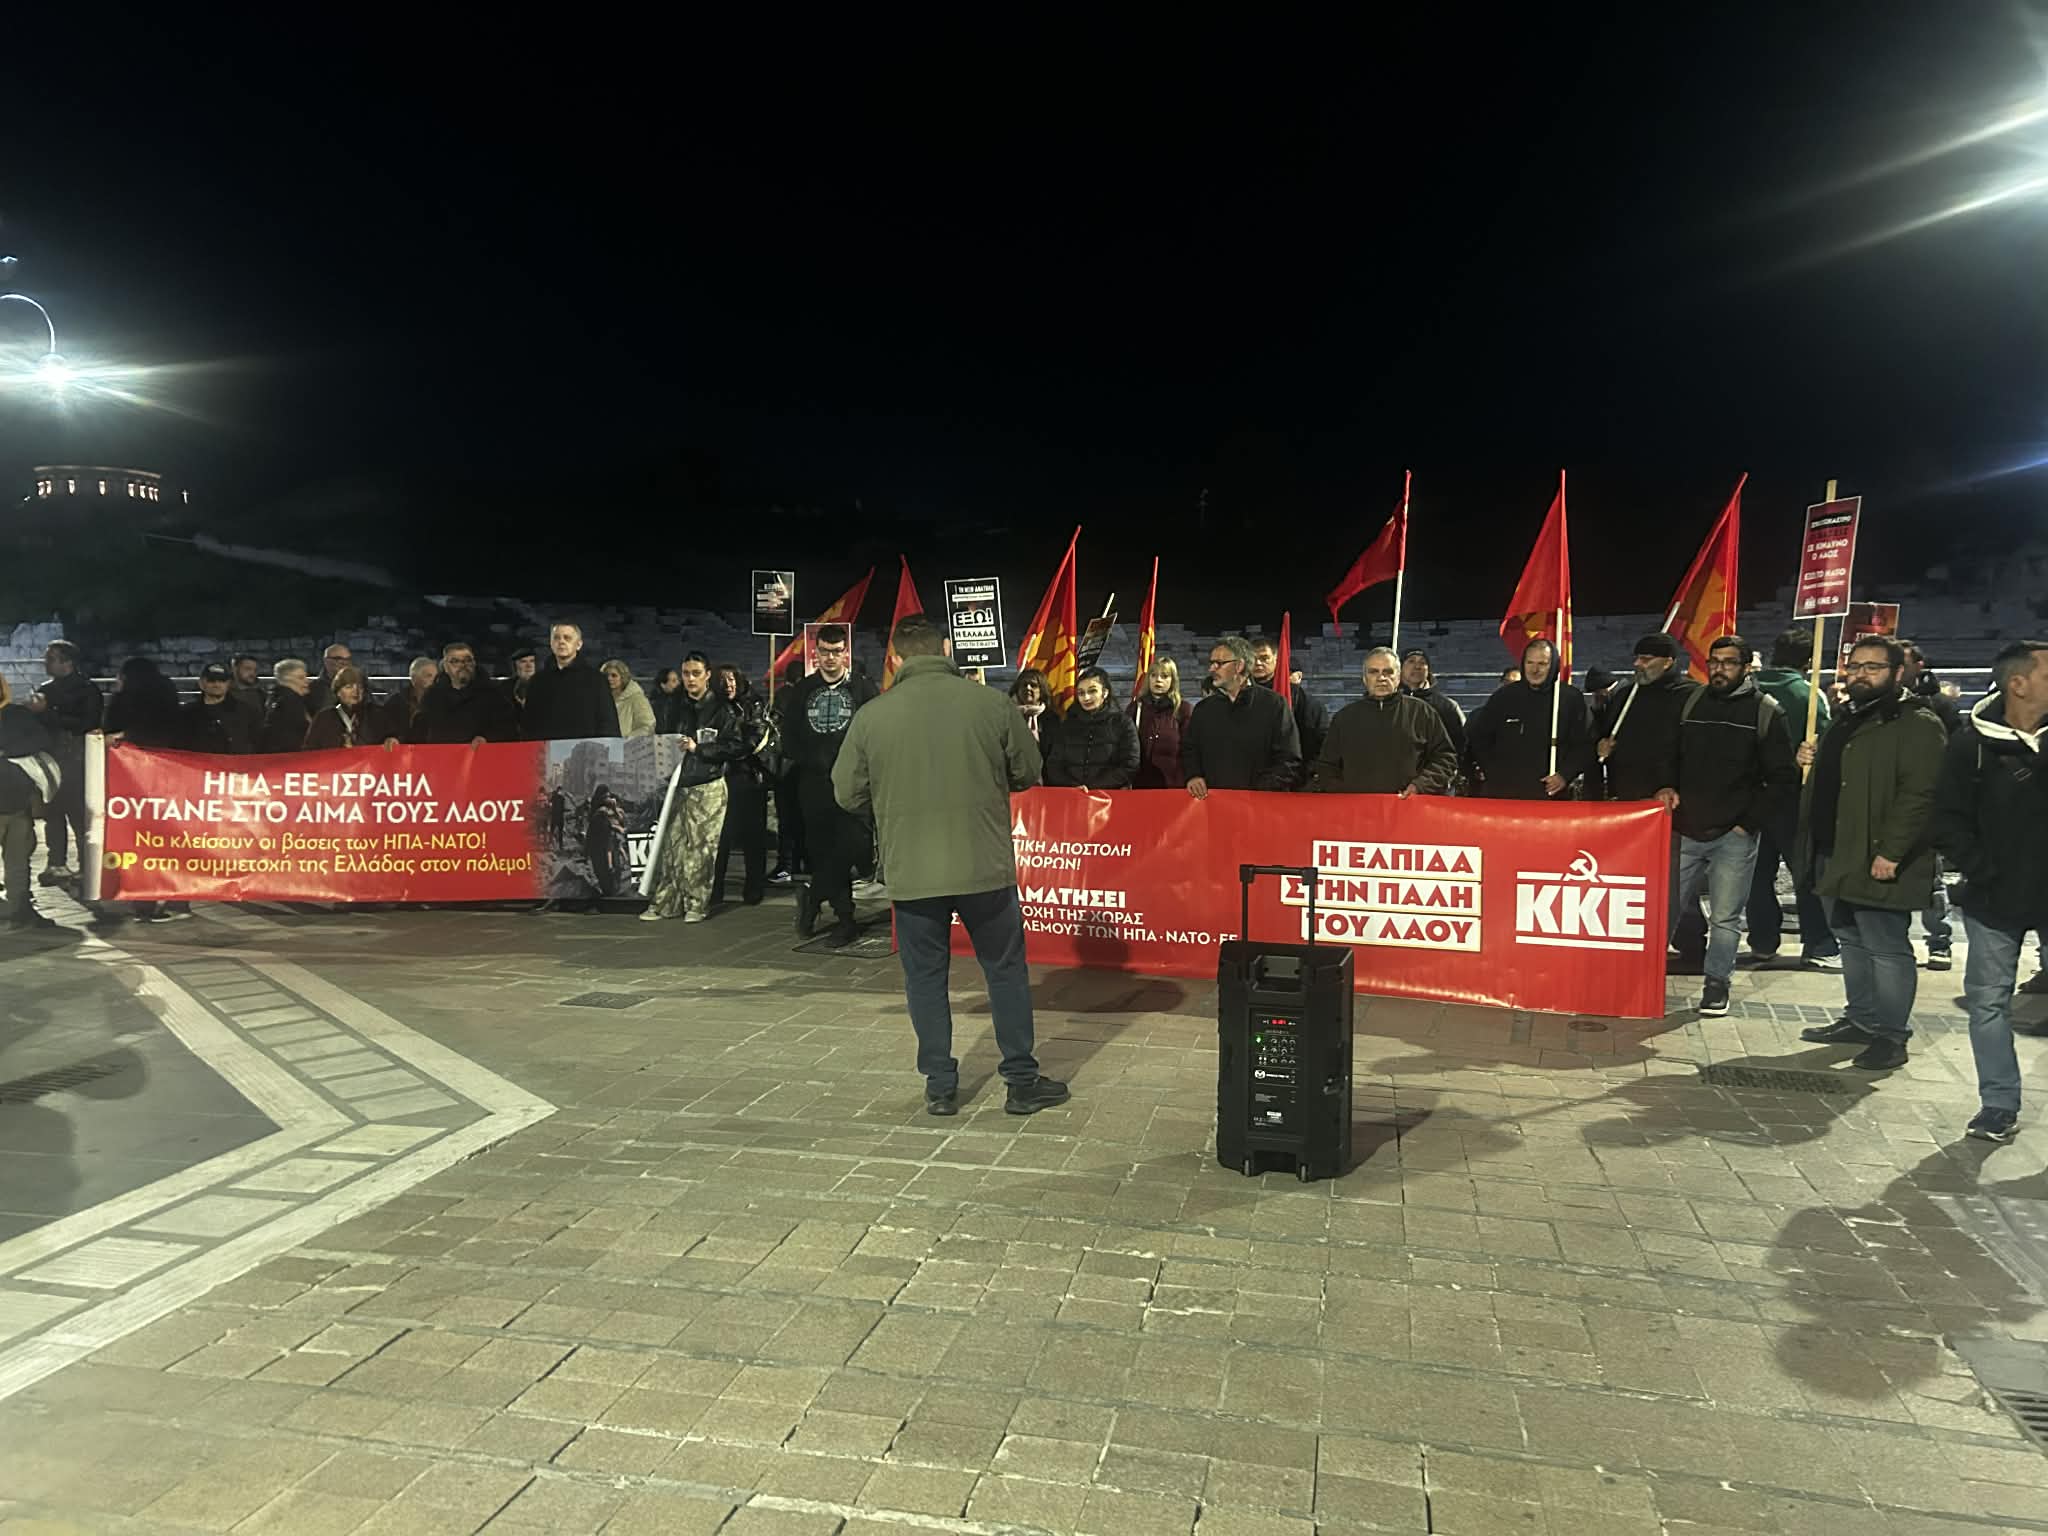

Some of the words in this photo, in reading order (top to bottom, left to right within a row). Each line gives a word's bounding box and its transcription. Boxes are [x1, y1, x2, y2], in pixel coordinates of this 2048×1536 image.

[955, 608, 992, 626] ΕΞΩ!
[963, 630, 995, 638] ΕΛΛΑΔΑ
[203, 771, 433, 797] ΗΠΑ-ΕΕ-ΙΣΡΑΗΛ
[231, 800, 288, 822] ΣΤΟ
[295, 802, 364, 823] ΑΙΜΑ
[372, 802, 438, 823] ΤΟΥΣ
[444, 800, 525, 823] ΛΑΟΥΣ
[135, 831, 164, 847] Να
[170, 831, 253, 849] κλείσουν
[259, 837, 276, 849] οι
[282, 832, 340, 853] βάσεις
[346, 837, 378, 849] των
[384, 832, 487, 849] ΗΠΑ-ΝΑΤΟ!
[1049, 841, 1132, 857] ΑΠΟΣΤΟΛΗ
[143, 856, 179, 871] στη
[186, 854, 291, 876] συμμετοχή
[299, 857, 328, 875] της
[334, 853, 415, 875] Ελλάδας
[420, 858, 461, 872] στον
[466, 852, 532, 875] πόλεμο!
[1319, 845, 1339, 867] Η
[1349, 847, 1474, 873] ΕΛΠΙΔΑ
[1378, 882, 1473, 908] ΠΑΛΗ
[1020, 905, 1054, 919] ΟΧΗ
[1057, 908, 1087, 921] ΤΗΣ
[1090, 910, 1144, 925] ΧΩΡΑΣ
[1515, 883, 1646, 939] ΚΚΕ
[1086, 924, 1119, 940] ΤΩΝ
[1124, 928, 1157, 942] ΗΠΑ
[1166, 930, 1210, 944] ΝΑΤΟ
[1306, 913, 1370, 936] ΤΟΥ
[1378, 917, 1473, 943] ΛΑΟΥ
